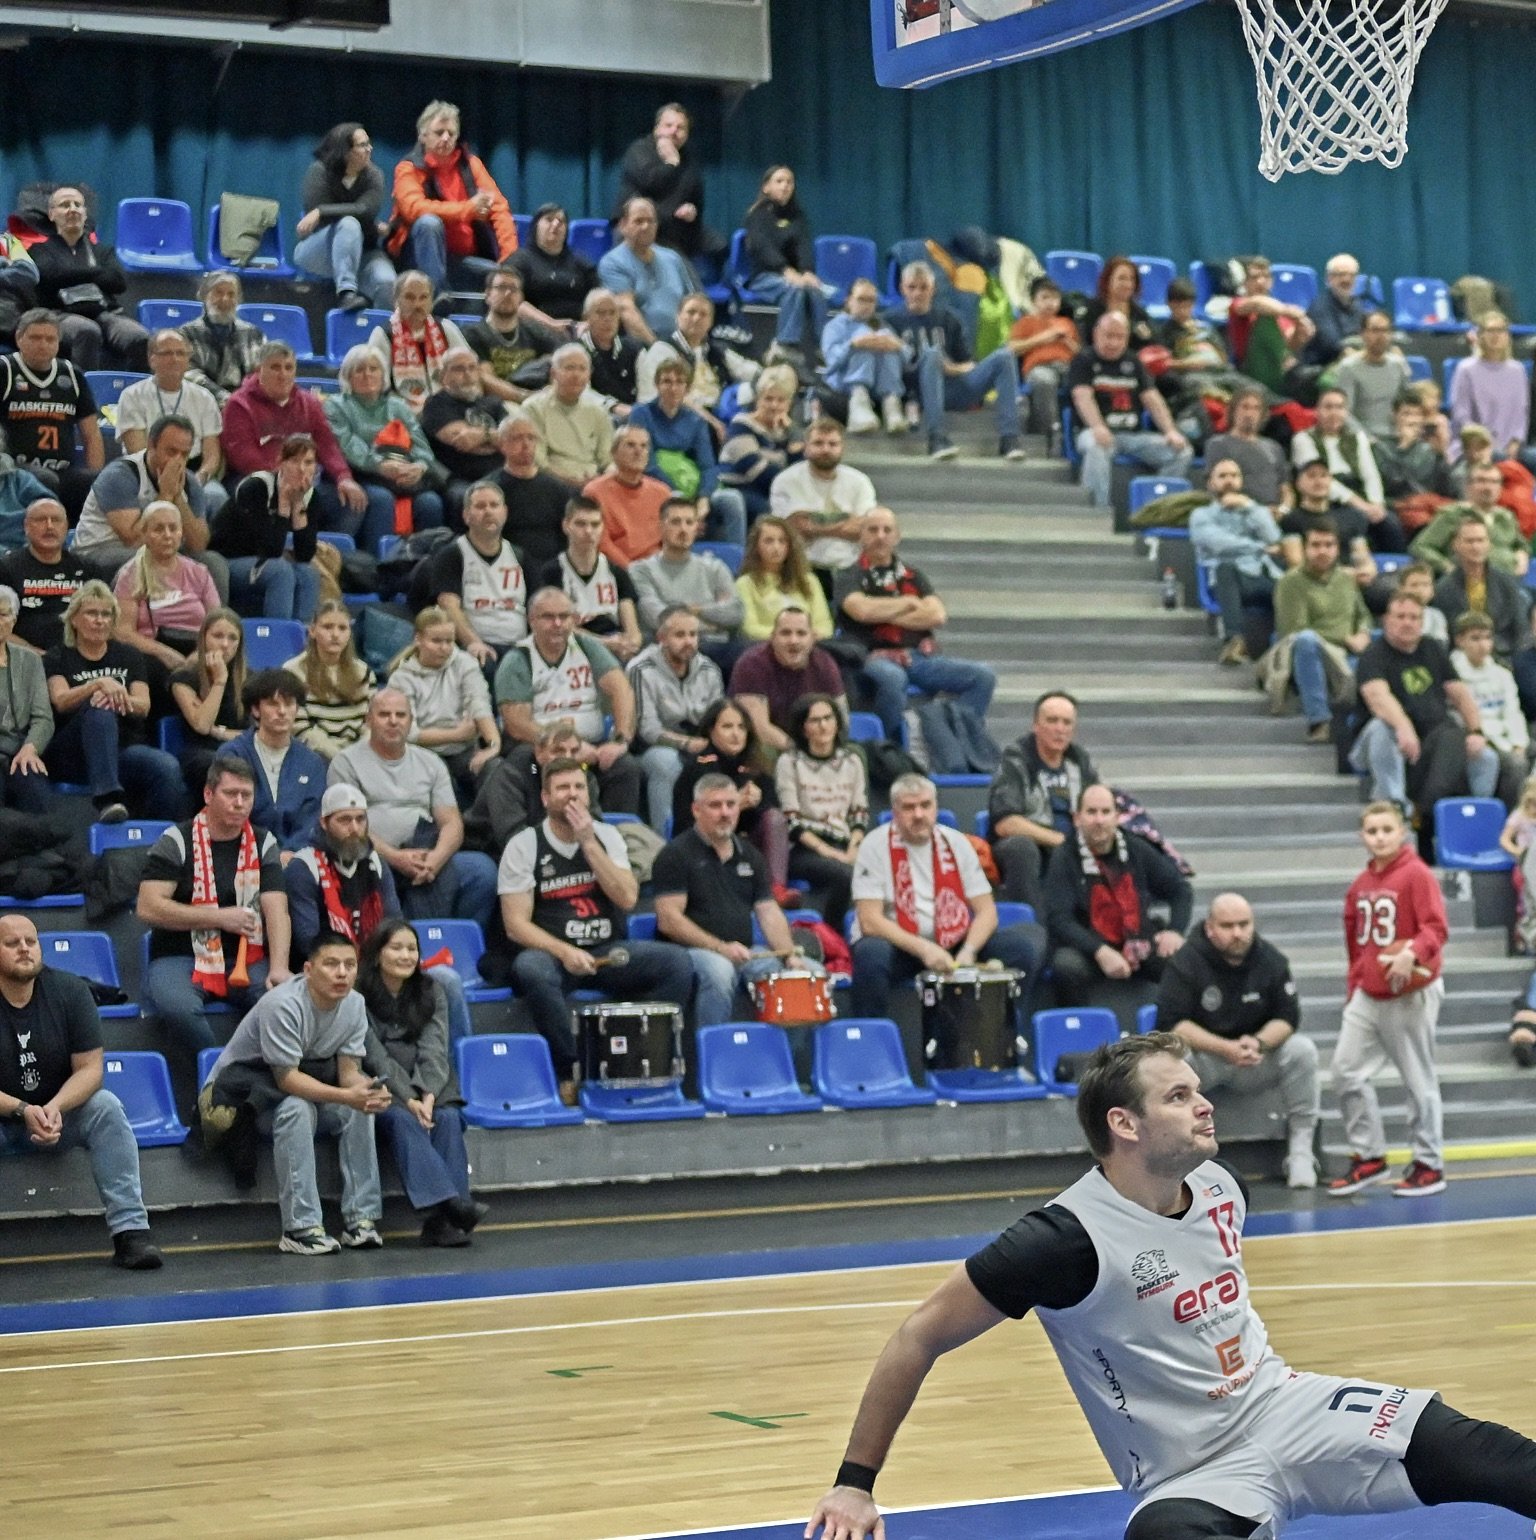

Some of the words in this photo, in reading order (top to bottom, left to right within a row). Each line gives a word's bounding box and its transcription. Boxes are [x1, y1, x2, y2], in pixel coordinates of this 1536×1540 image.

[38, 425, 59, 450] 21
[499, 567, 521, 589] 77
[597, 582, 616, 604] 13
[569, 896, 600, 918] 31
[565, 918, 611, 939] era
[1208, 1200, 1239, 1257] 17
[1136, 1269, 1180, 1293] BASKETBALL
[1137, 1280, 1176, 1301] NYMBURK
[1173, 1271, 1240, 1324] era
